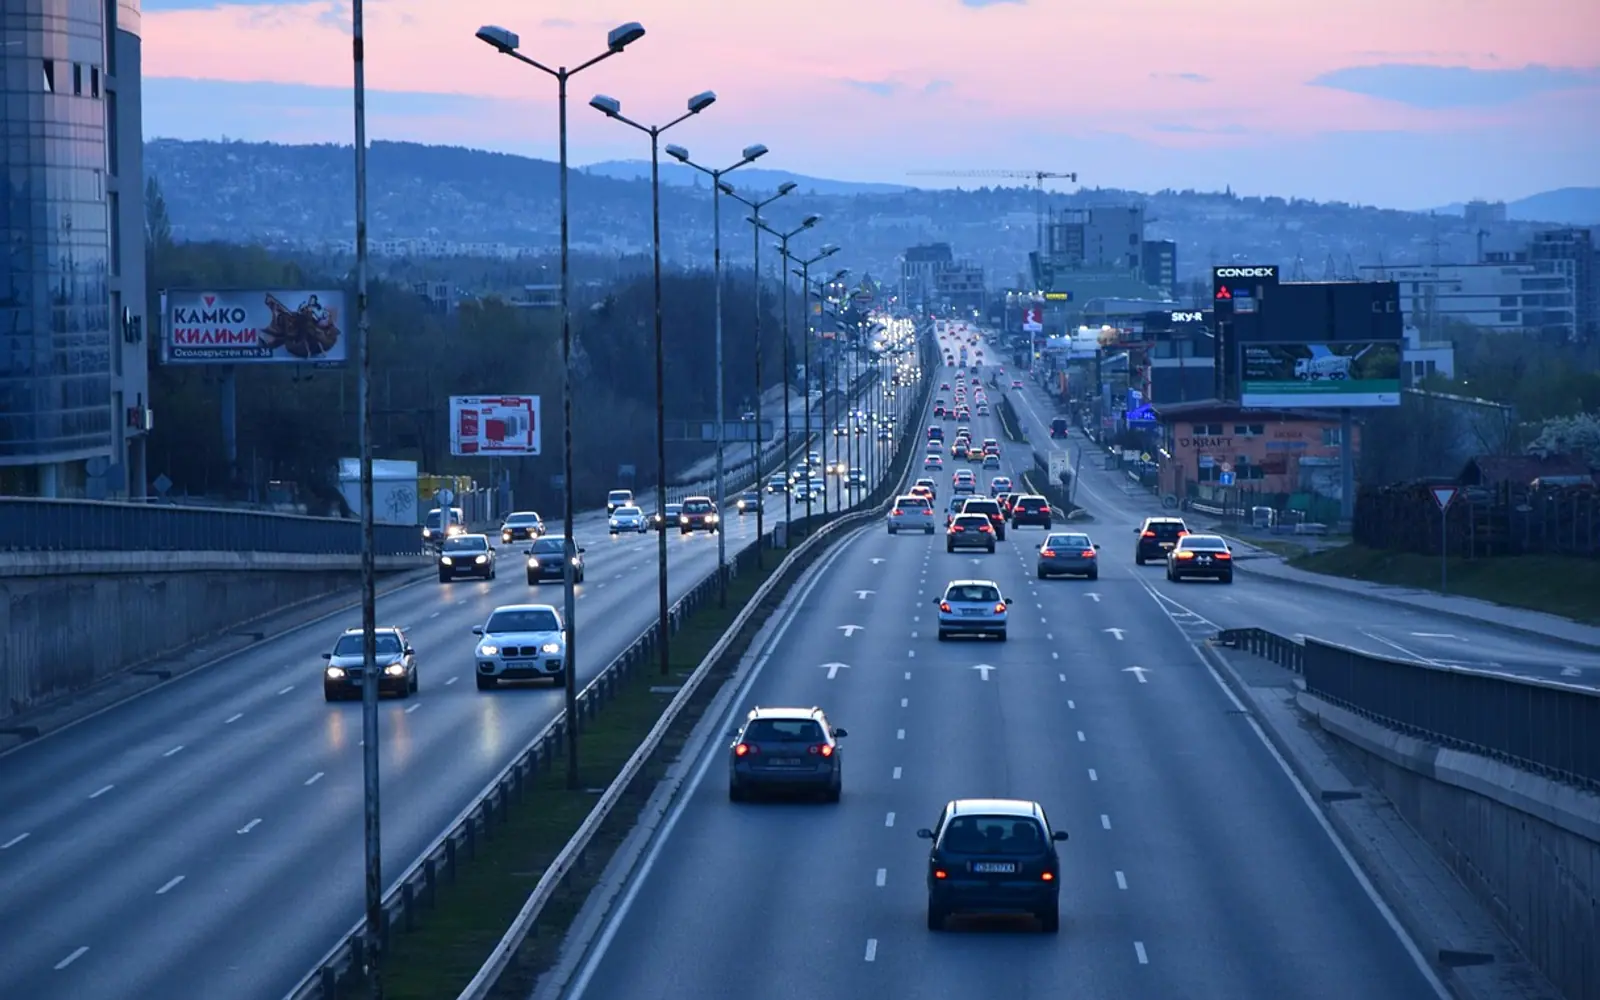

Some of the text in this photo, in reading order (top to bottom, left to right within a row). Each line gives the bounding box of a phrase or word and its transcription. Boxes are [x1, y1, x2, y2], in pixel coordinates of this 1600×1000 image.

[1217, 268, 1273, 277] CONDEX
[174, 308, 246, 324] КАМКО
[174, 328, 257, 344] КИЛИМИ
[1192, 438, 1233, 448] KRAFT
